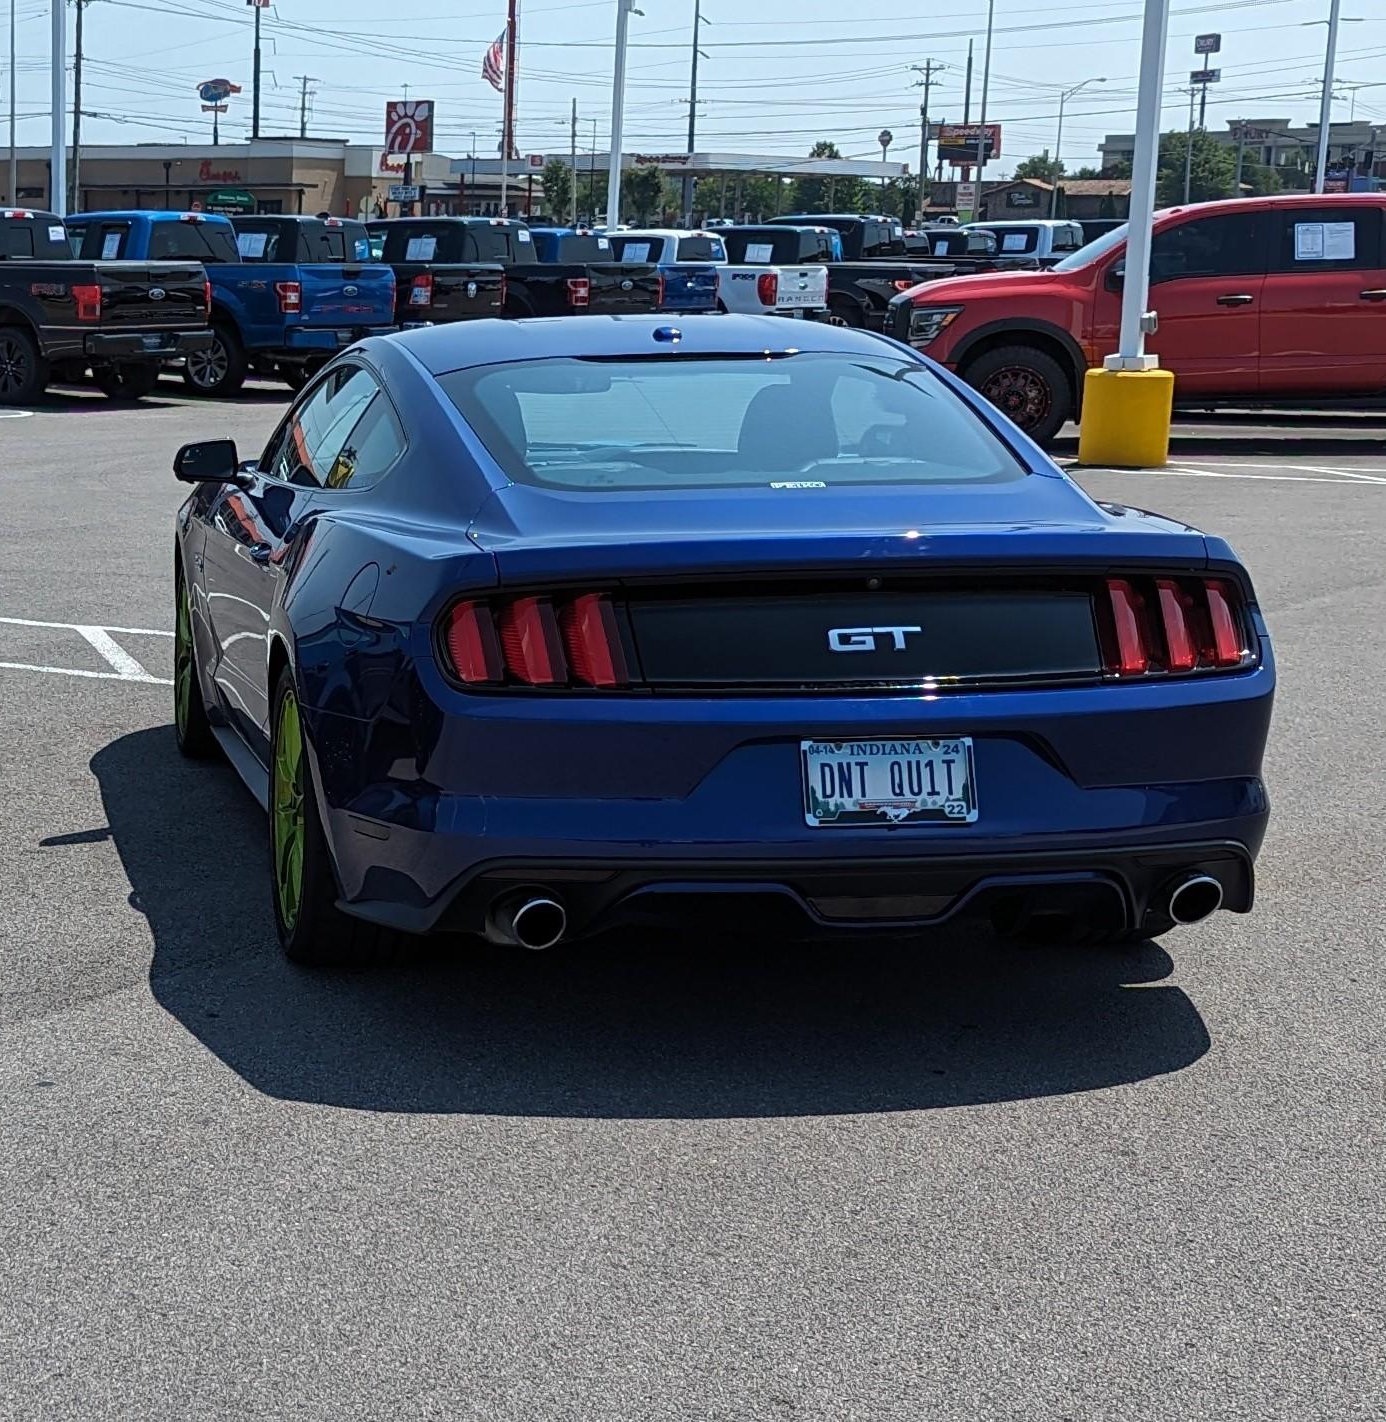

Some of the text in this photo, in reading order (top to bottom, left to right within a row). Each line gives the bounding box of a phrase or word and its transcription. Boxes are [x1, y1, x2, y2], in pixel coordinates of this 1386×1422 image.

[944, 126, 994, 137] Speeday
[827, 626, 922, 652] GT
[849, 743, 924, 756] INDIANA
[943, 744, 960, 755] 24
[820, 759, 956, 799] DNT QU1T
[947, 804, 964, 815] 22
